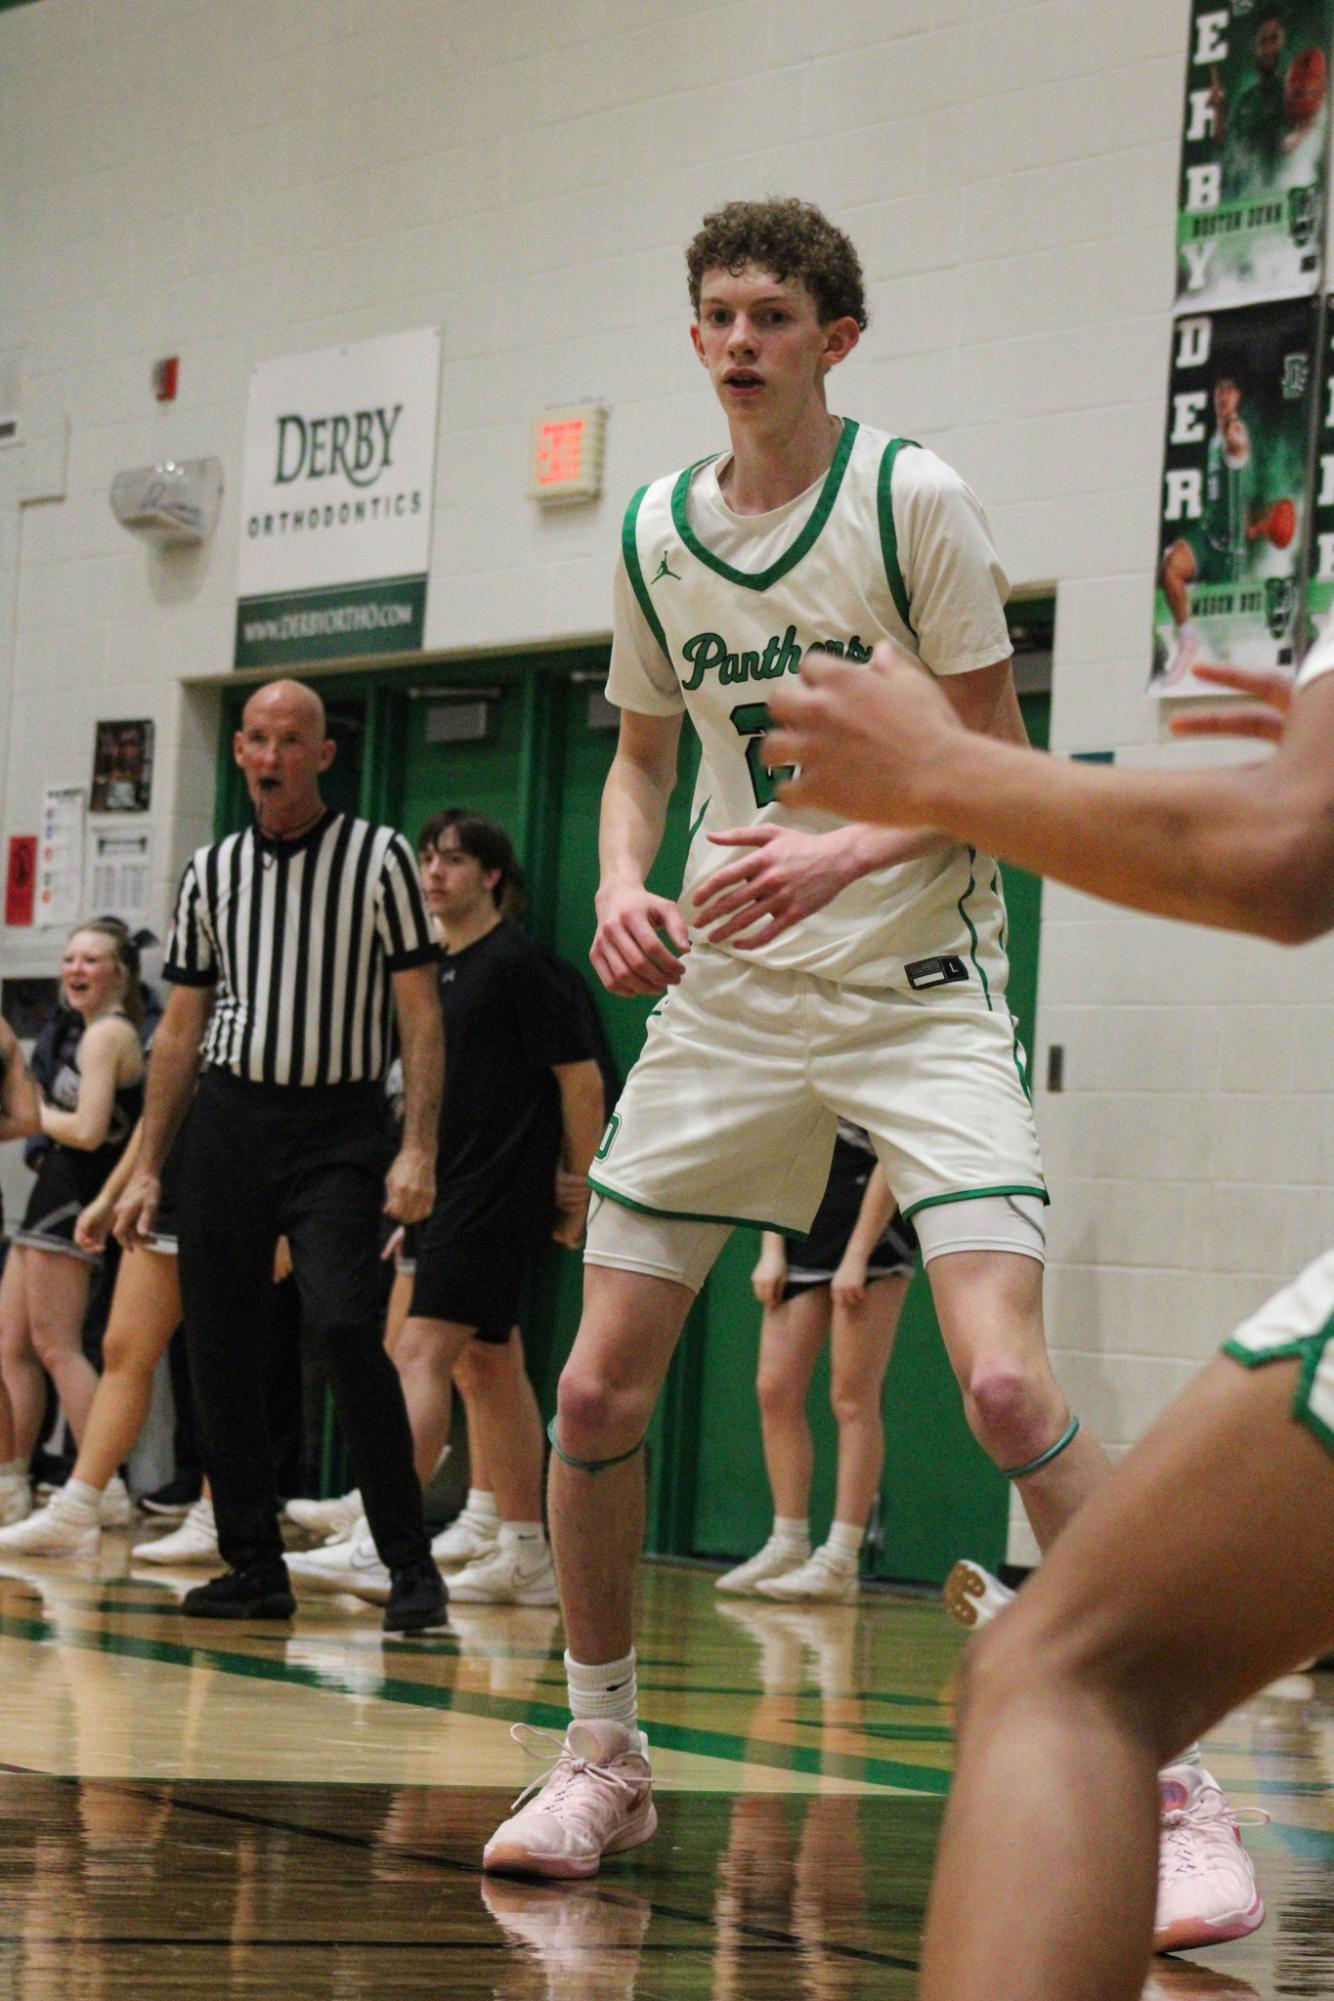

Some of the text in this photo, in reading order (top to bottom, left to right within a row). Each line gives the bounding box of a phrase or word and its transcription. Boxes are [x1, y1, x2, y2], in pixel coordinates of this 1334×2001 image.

[274, 403, 403, 488] DERBY
[248, 491, 421, 538] ORTHODONTICS
[949, 961, 960, 974] L
